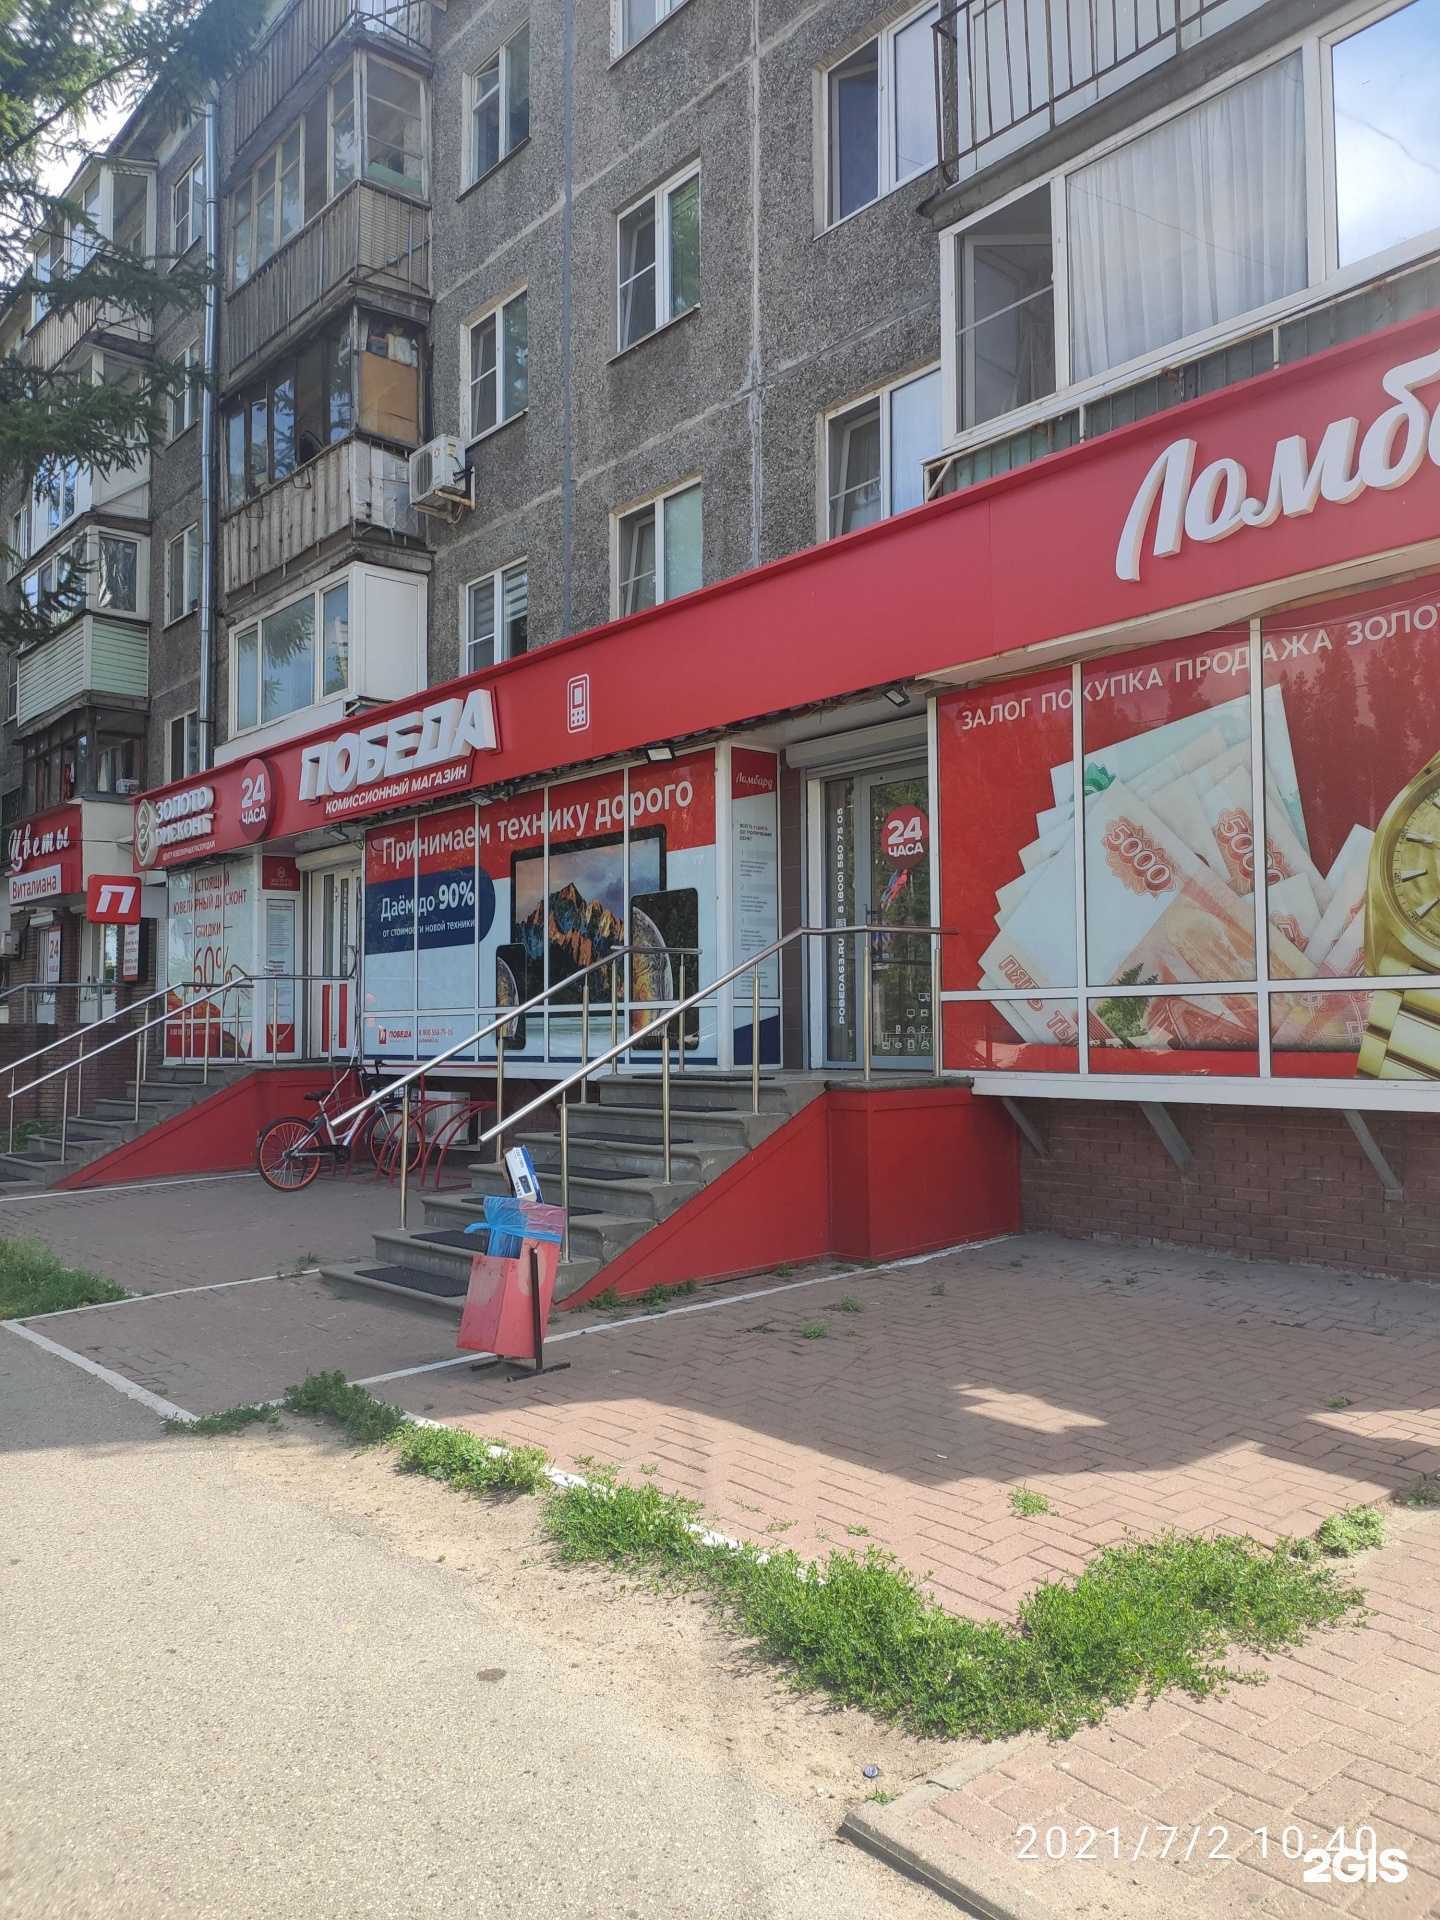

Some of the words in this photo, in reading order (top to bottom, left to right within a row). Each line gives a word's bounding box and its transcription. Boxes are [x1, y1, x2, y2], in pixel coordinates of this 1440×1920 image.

[961, 697, 1032, 731] ЗАЛОГ
[1040, 667, 1164, 715] ПОКУПКА
[1174, 628, 1334, 684] ПРОДАЖА
[1346, 603, 1440, 646] ЗОЛО
[299, 688, 497, 800] ПОБЕДА
[241, 773, 266, 809] 24
[325, 776, 410, 815] КОМИССИОННЫЙ
[411, 764, 467, 791] МАГАЗИН
[735, 772, 774, 791] Ломбард
[155, 786, 214, 824] ЗОЛОТО
[241, 806, 267, 825] ЧАСА
[836, 808, 844, 822] 05
[382, 823, 491, 869] Принимаем
[497, 802, 590, 842] технику
[595, 780, 693, 831] дорого
[836, 825, 844, 841] 75
[887, 816, 923, 845] 24
[9, 823, 70, 872] Цветы
[888, 843, 924, 857] ЧАСА
[1106, 821, 1173, 887] 5000
[12, 874, 57, 900] Виталиана
[96, 884, 136, 914] П
[380, 894, 414, 922] Даём
[418, 895, 435, 918] до
[438, 879, 475, 910] 90%
[837, 872, 845, 903] (800)
[837, 905, 844, 914] 8
[382, 929, 390, 938] от
[425, 920, 446, 933] новой
[446, 918, 476, 930] техники
[838, 938, 846, 1024] POBEDA63.RU
